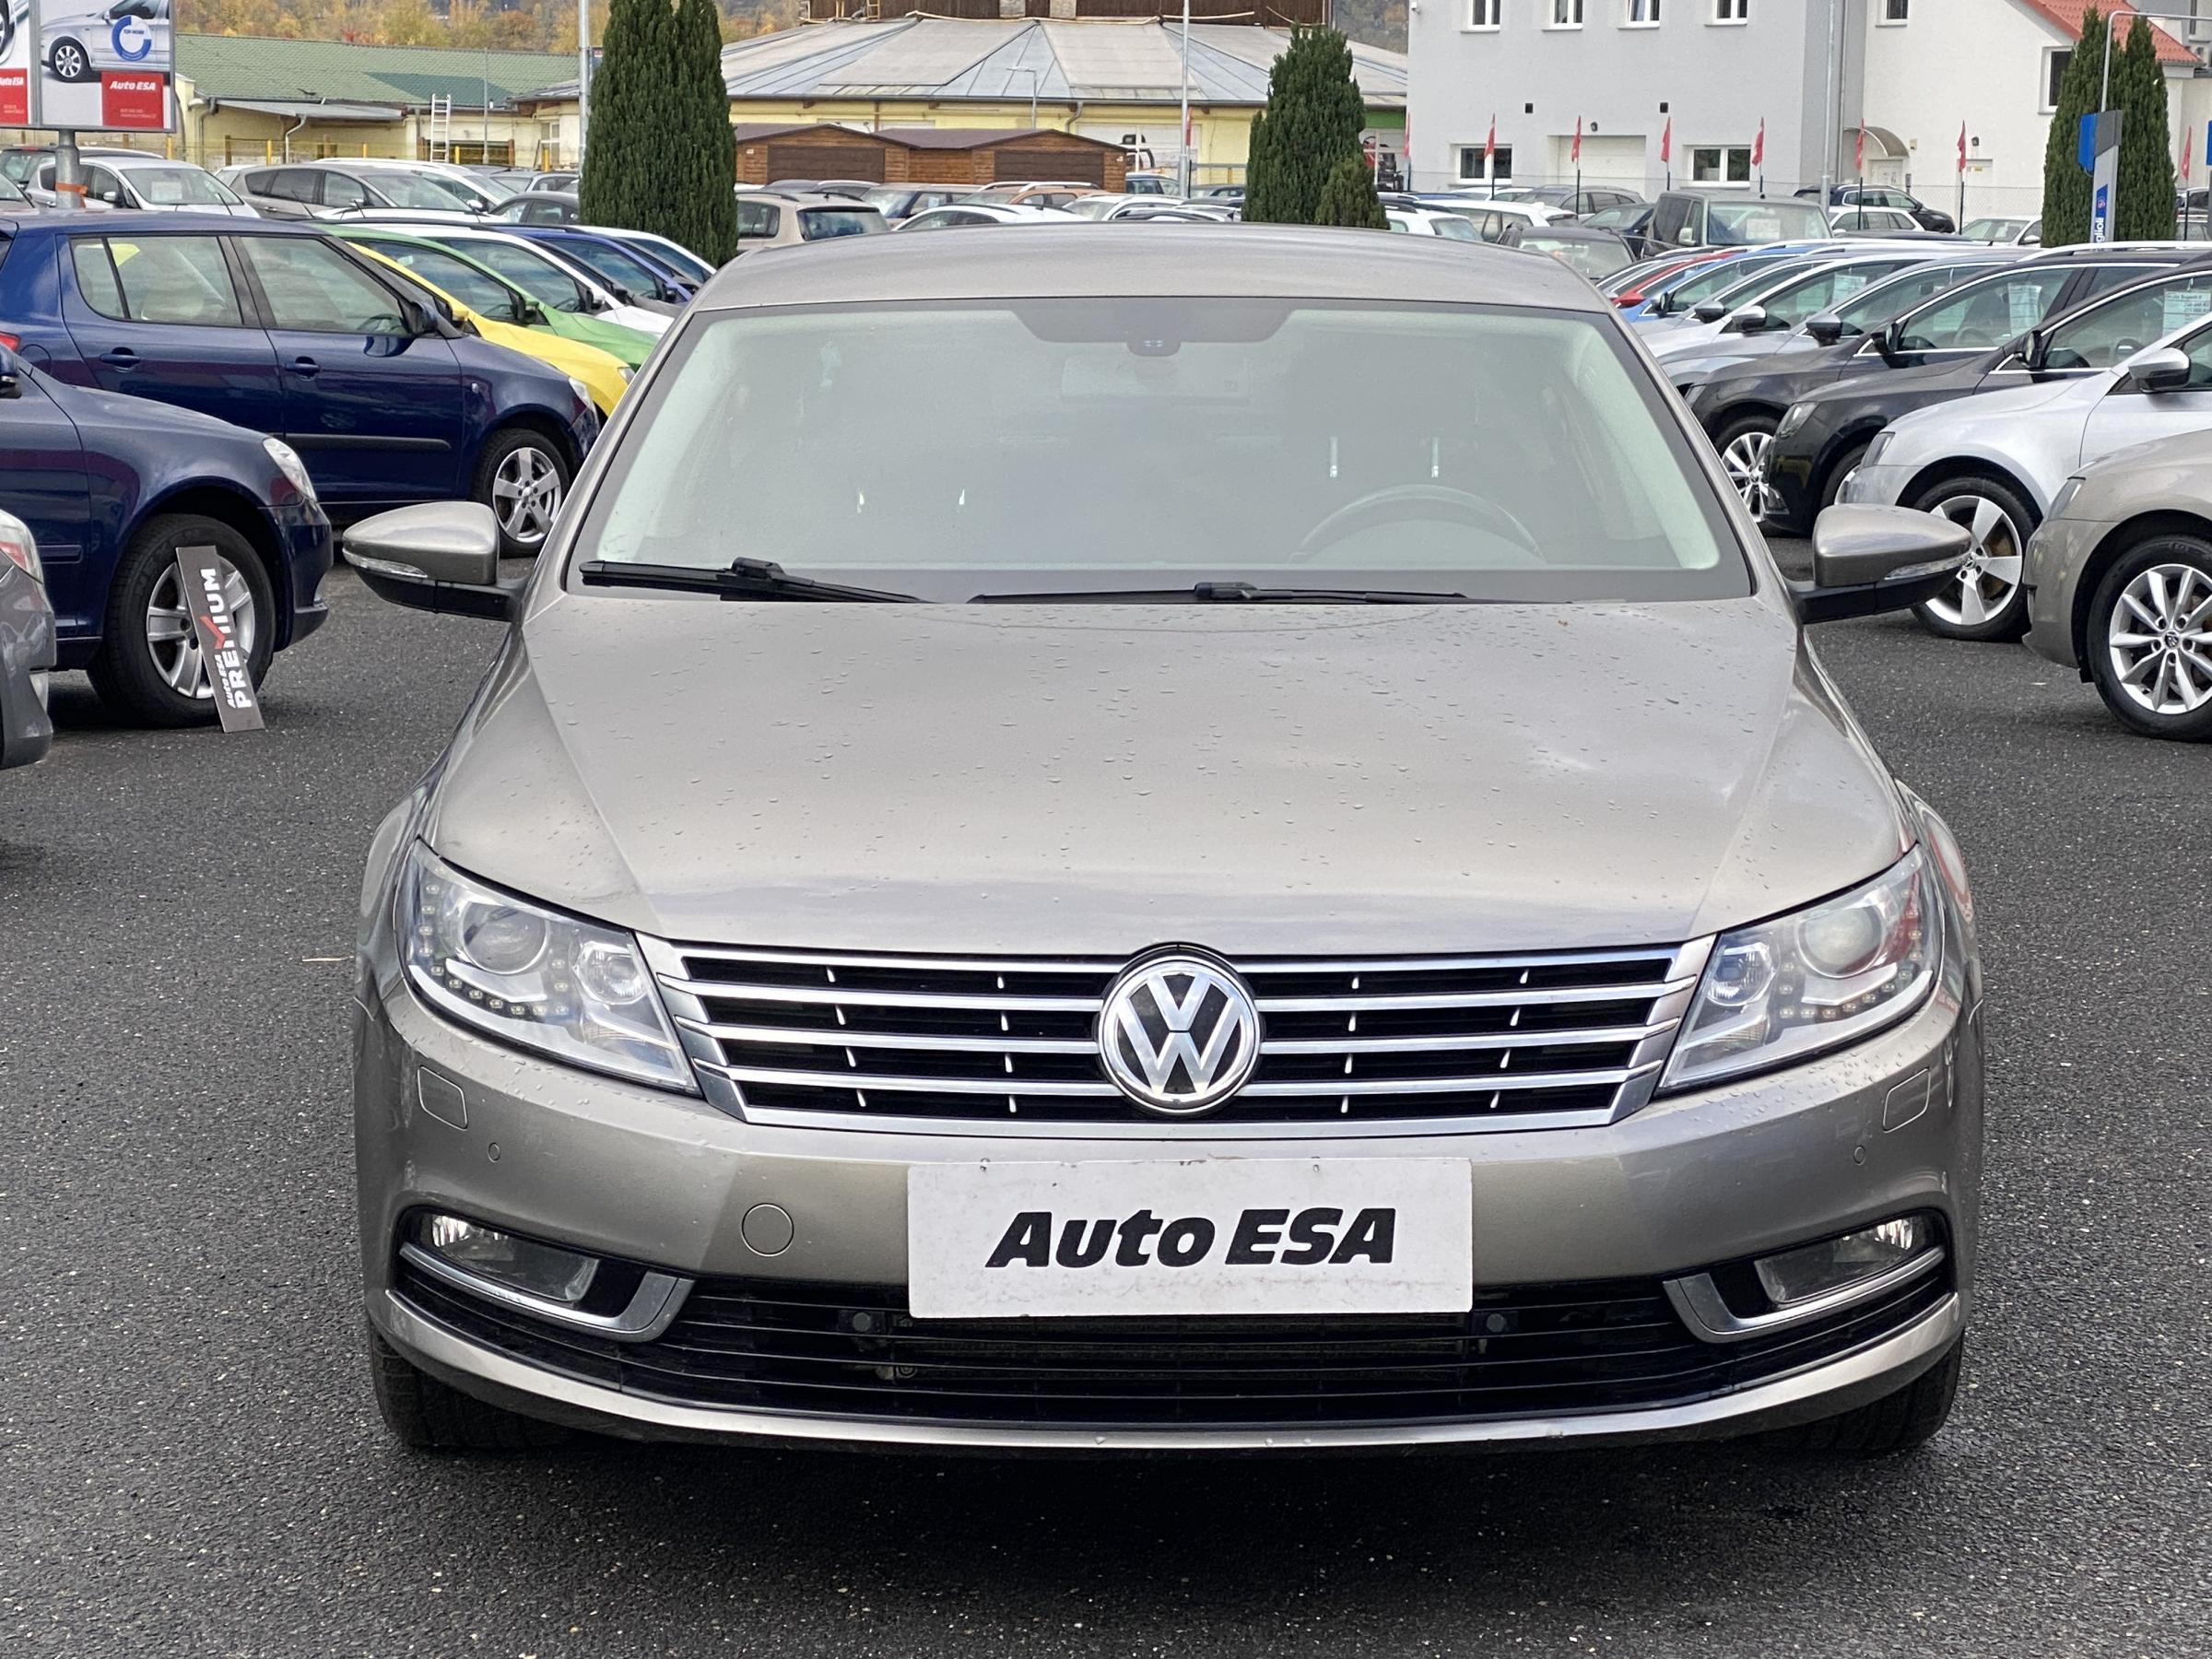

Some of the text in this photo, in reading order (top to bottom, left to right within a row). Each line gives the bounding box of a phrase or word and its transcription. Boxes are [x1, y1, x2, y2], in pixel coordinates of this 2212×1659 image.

[13, 76, 24, 86] ESA
[110, 80, 156, 91] Auto ESA
[199, 568, 253, 709] PREMIUM
[214, 654, 228, 677] ESA
[984, 1206, 1396, 1268] Auto ESA
